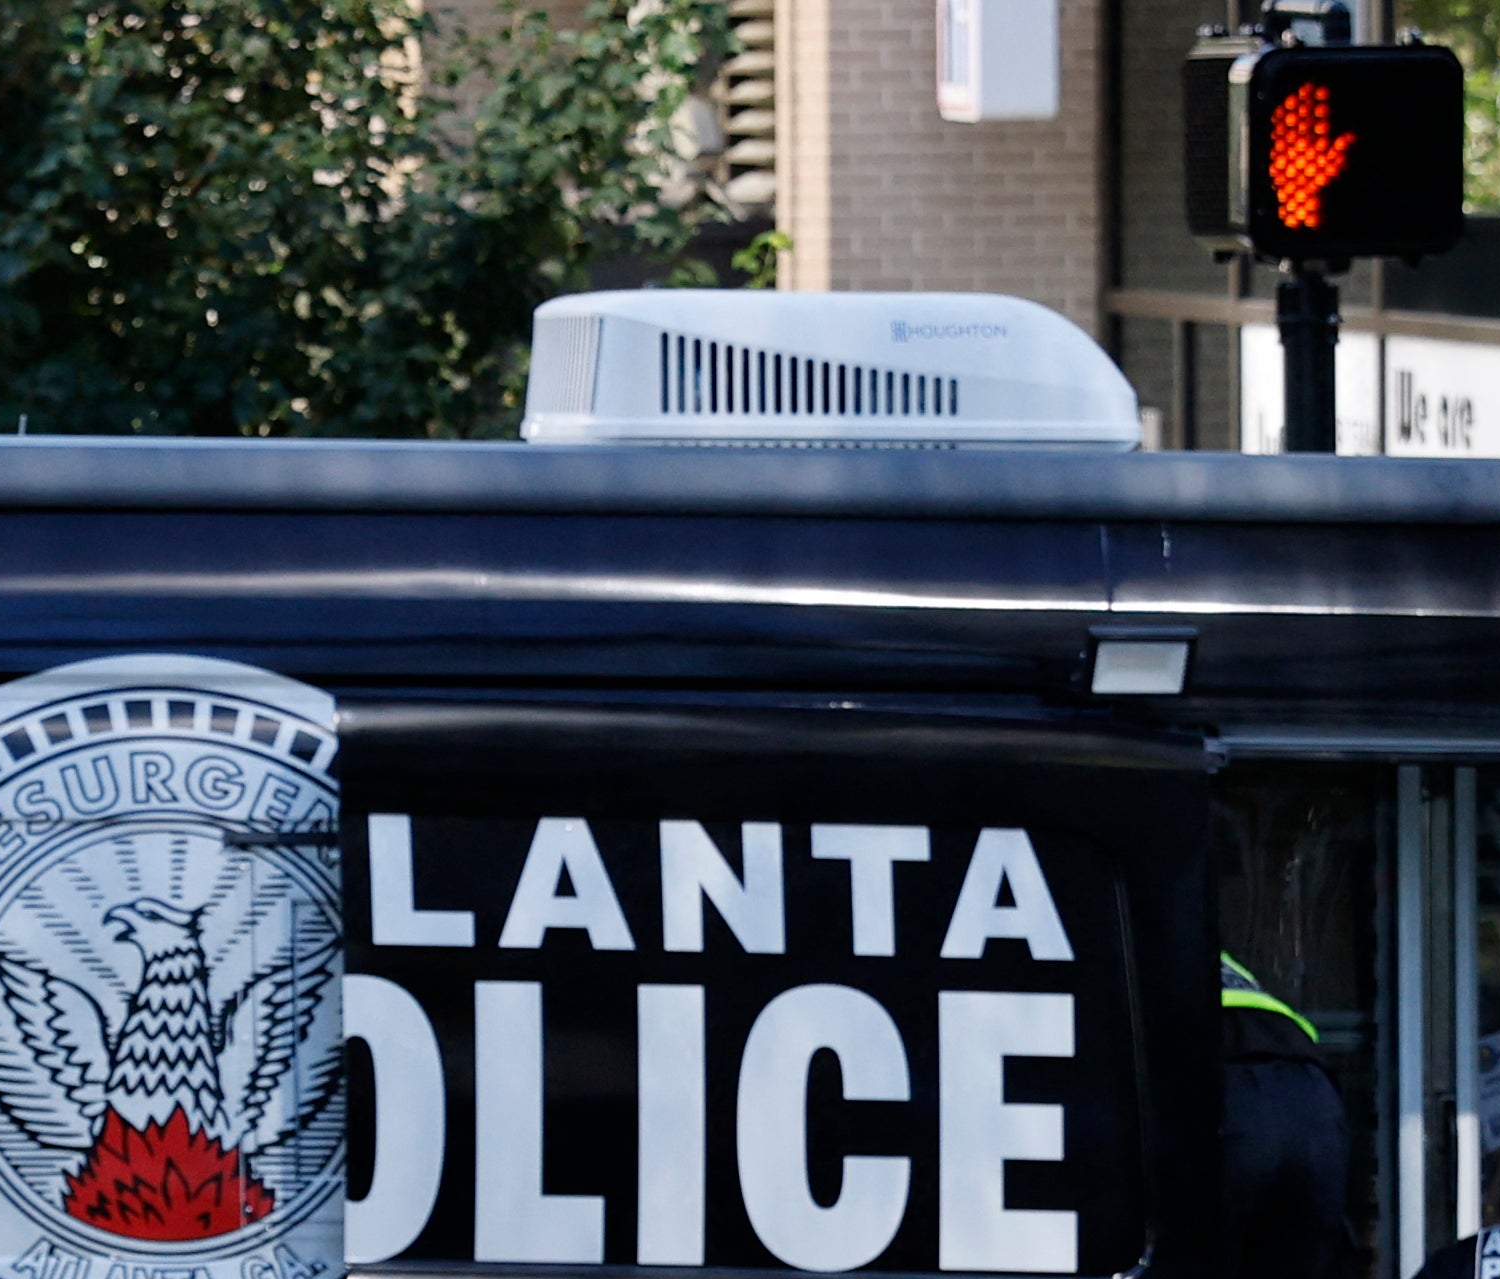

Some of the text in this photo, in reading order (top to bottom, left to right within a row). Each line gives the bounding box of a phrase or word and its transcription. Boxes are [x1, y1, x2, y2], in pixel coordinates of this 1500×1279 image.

[1395, 370, 1428, 445] We
[1438, 394, 1475, 450] are
[367, 812, 1076, 962] LANTA
